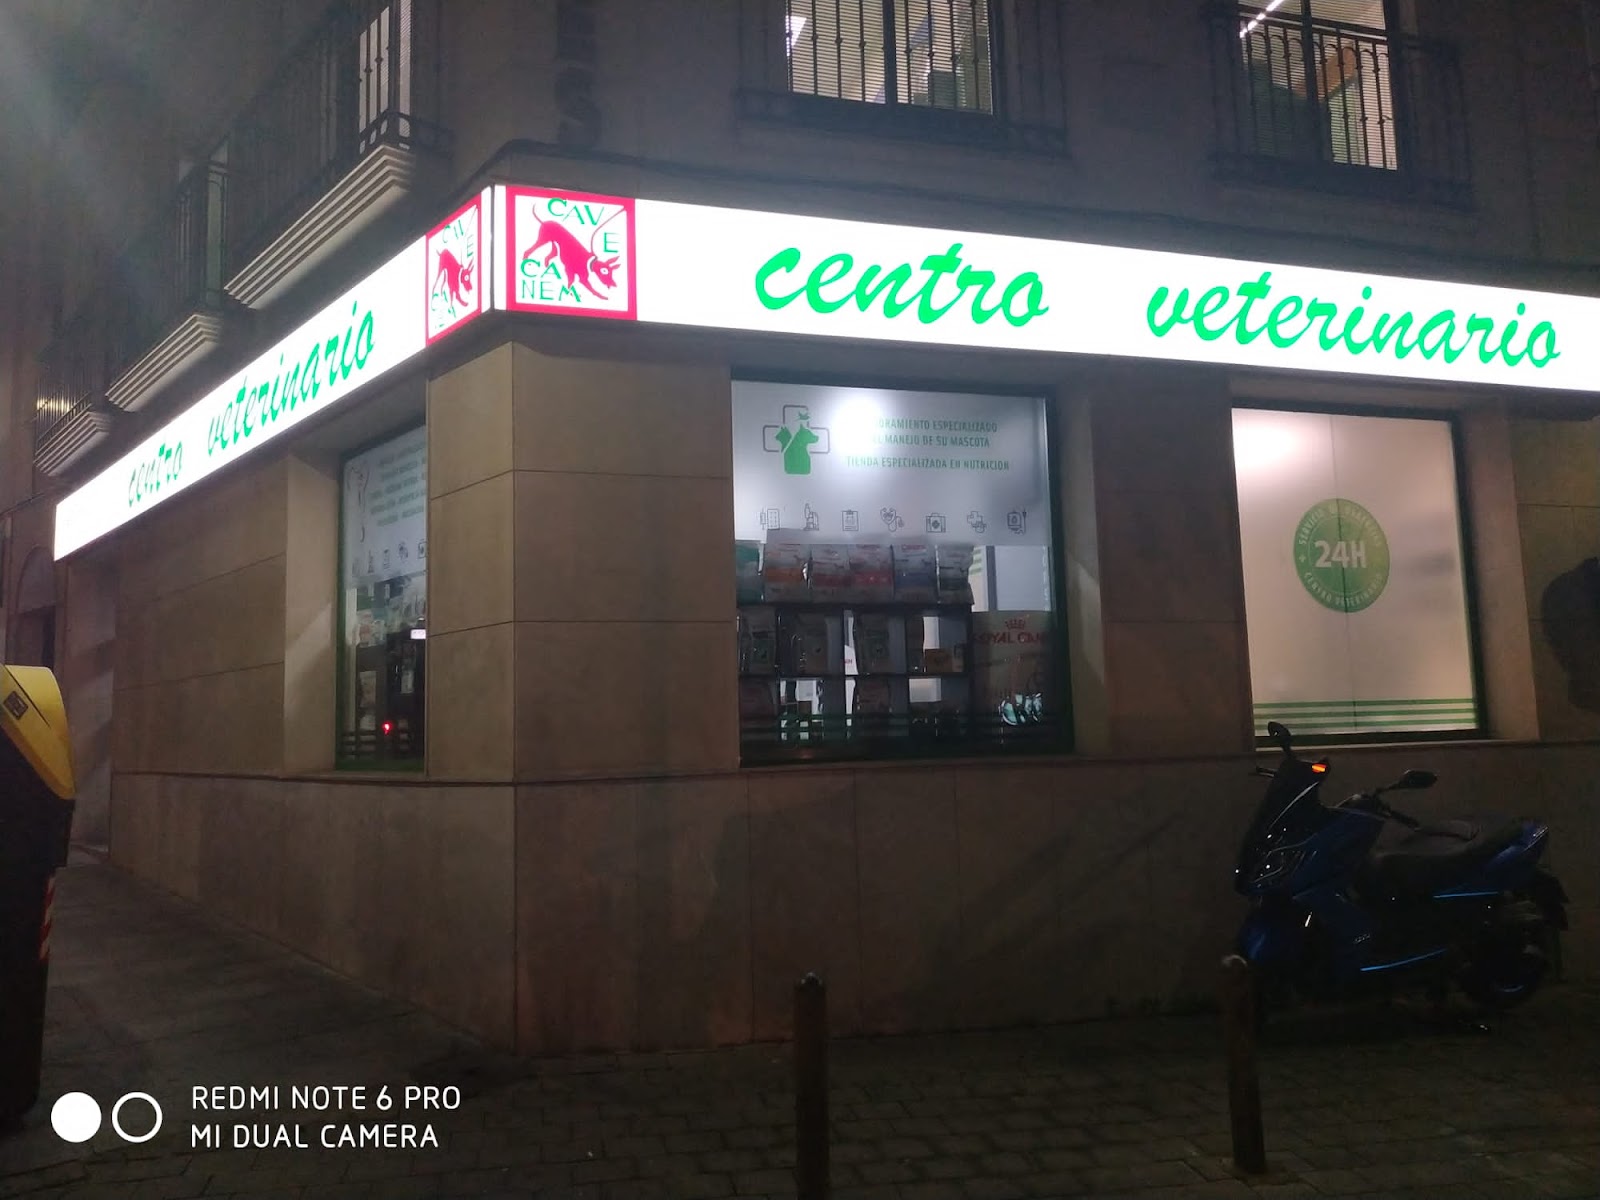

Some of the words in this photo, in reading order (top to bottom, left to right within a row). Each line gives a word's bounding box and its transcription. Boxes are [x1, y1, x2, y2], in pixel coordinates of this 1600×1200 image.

[754, 242, 1050, 329] centro
[1145, 270, 1562, 369] veterinario
[207, 298, 376, 457] veterinario
[932, 419, 998, 433] ESPECIALIZADO
[884, 434, 920, 446] MANEJO
[922, 435, 933, 446] DE
[936, 435, 948, 447] SU
[950, 436, 990, 448] MASCOTA
[846, 455, 879, 468] TIENDA
[881, 457, 947, 469] ESPECIALIZADA
[1314, 540, 1367, 568] 24H
